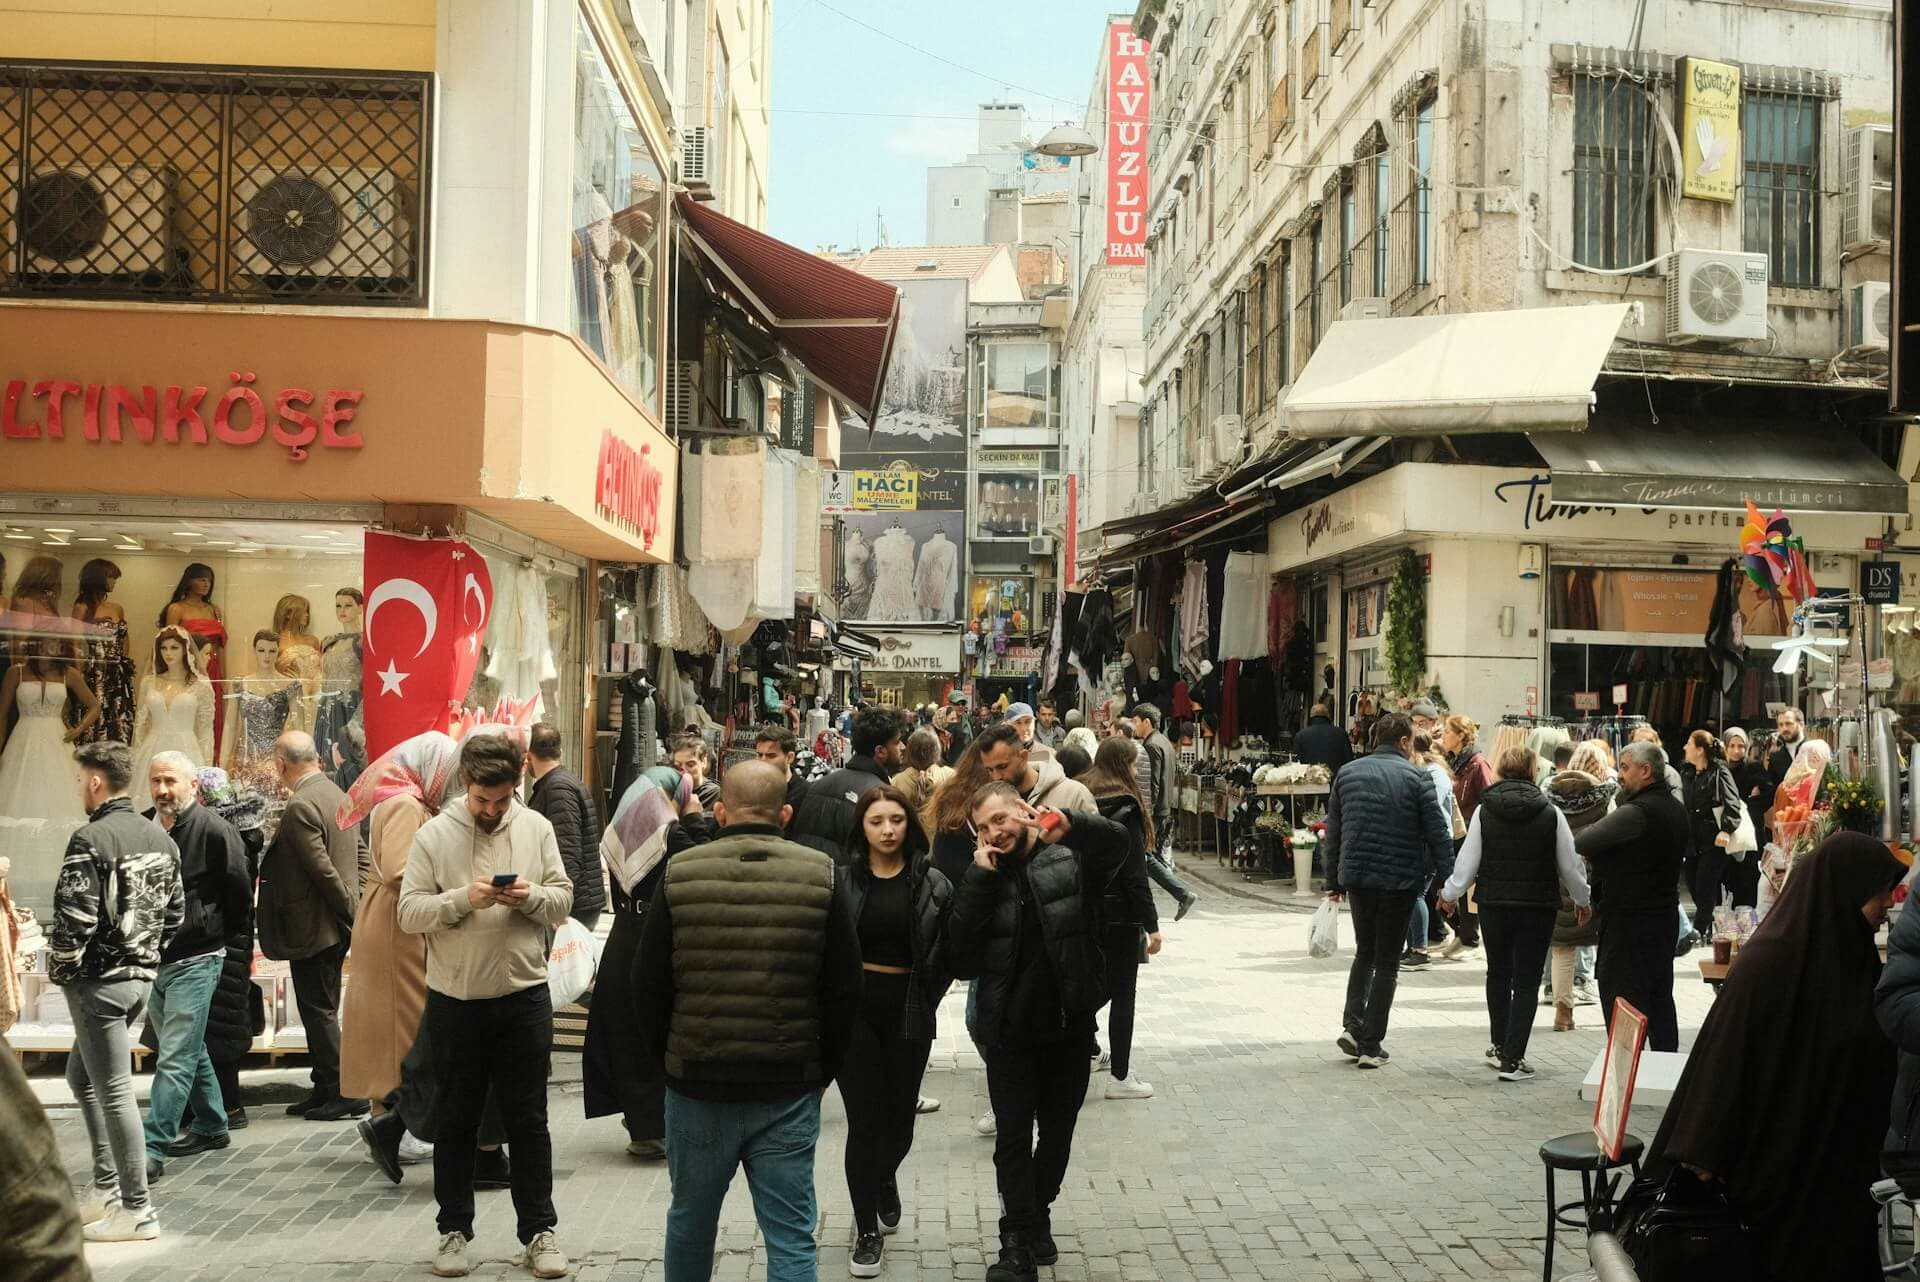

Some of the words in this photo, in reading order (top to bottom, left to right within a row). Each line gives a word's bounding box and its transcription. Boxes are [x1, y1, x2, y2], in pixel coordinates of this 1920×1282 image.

[1116, 32, 1145, 235] HAVUZLU
[1110, 242, 1145, 258] HAN
[2, 371, 366, 462] LTINKÖŞE
[857, 478, 913, 492] HACI
[1868, 567, 1892, 586] D'S
[892, 655, 943, 669] DANTEL
